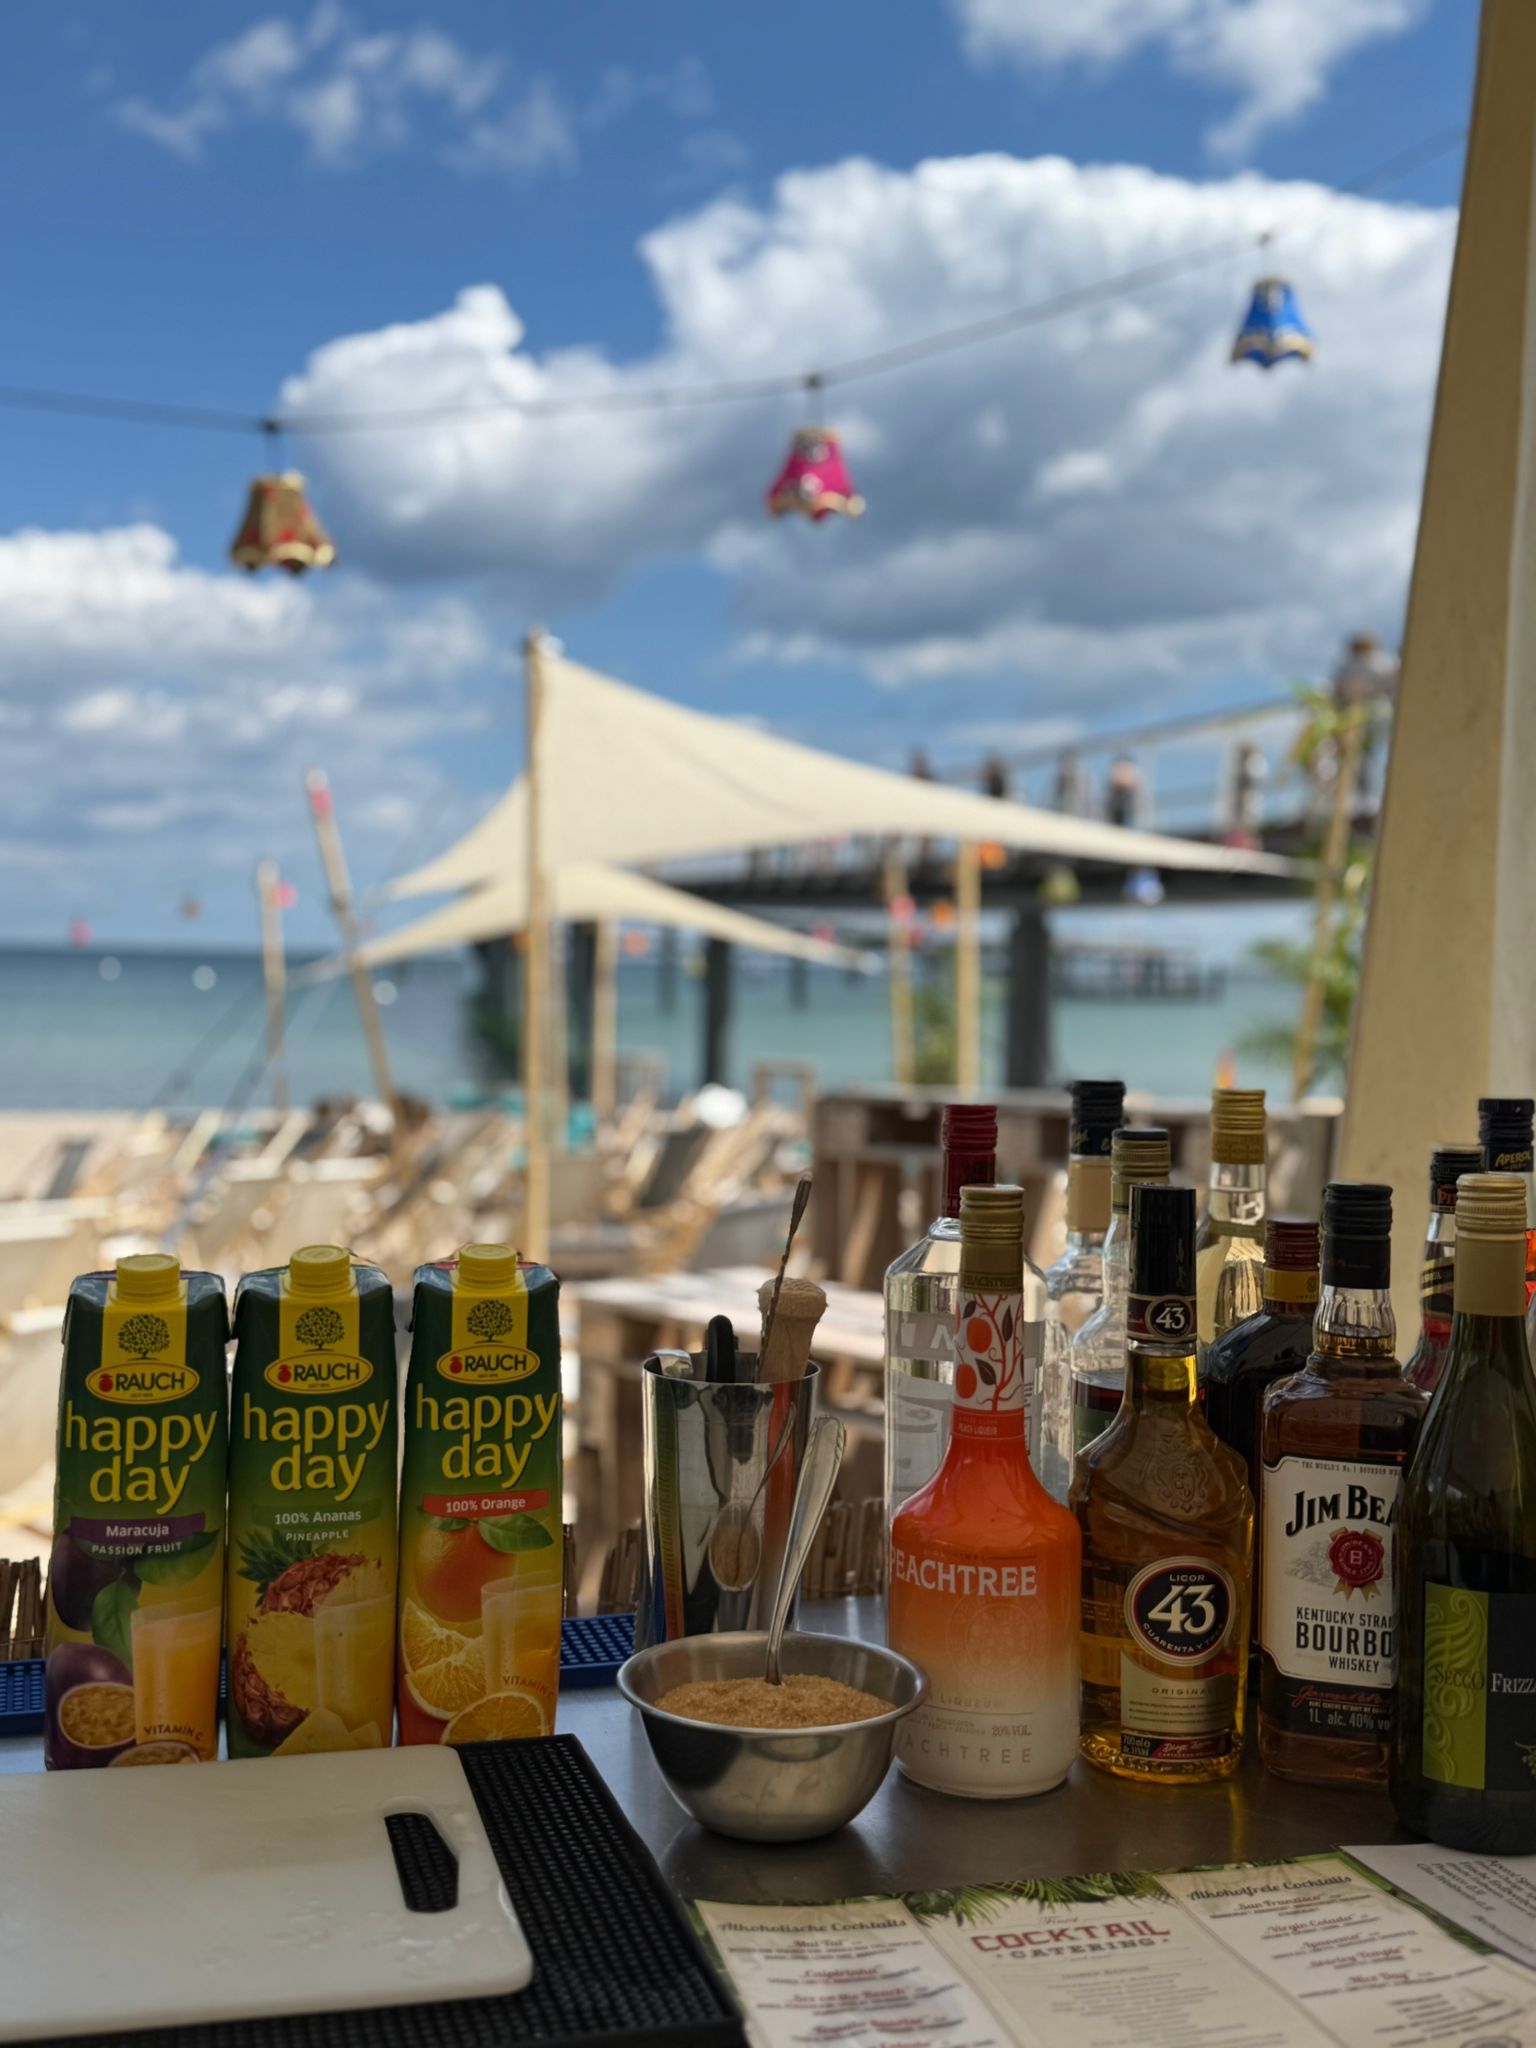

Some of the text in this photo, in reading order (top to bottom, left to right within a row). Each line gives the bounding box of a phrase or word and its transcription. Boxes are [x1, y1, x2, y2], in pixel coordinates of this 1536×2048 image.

[1155, 1306, 1186, 1330] 43
[294, 1362, 360, 1382] RAUCH
[465, 1354, 526, 1372] RAUCH
[115, 1371, 185, 1391] RAUCH
[416, 1382, 559, 1442] happy
[65, 1400, 217, 1465] happy
[244, 1392, 389, 1454] happy
[442, 1433, 533, 1489] day
[270, 1444, 367, 1502] day
[90, 1455, 189, 1515] day
[446, 1498, 527, 1513] 100% Orange
[1285, 1490, 1342, 1538] JIM
[275, 1511, 361, 1525] 100% Ananas
[106, 1524, 169, 1537] Maracuja
[286, 1530, 349, 1541] PINEAPPLE
[92, 1541, 183, 1555] PASSION FRUIT
[889, 1545, 1037, 1597] PEACHTREE
[1169, 1574, 1205, 1582] LICOR
[1148, 1584, 1216, 1635] 43
[1296, 1606, 1355, 1625] KENTUCKY
[1143, 1622, 1195, 1653] CUARENTA
[1296, 1621, 1392, 1658] BOURBO
[1329, 1655, 1380, 1673] WHISKEY
[503, 1675, 547, 1696] VITAMIN
[1309, 1708, 1321, 1723] 1L
[1327, 1711, 1346, 1726] alc.
[1349, 1713, 1374, 1729] 40%
[144, 1723, 204, 1742] VITAMIN C
[1283, 1875, 1352, 1890] Cocktails
[718, 1918, 906, 1933] Alkoholische Cocktails
[970, 1920, 1171, 1952] COCKTAIL
[1010, 1938, 1156, 1959] CATERING
